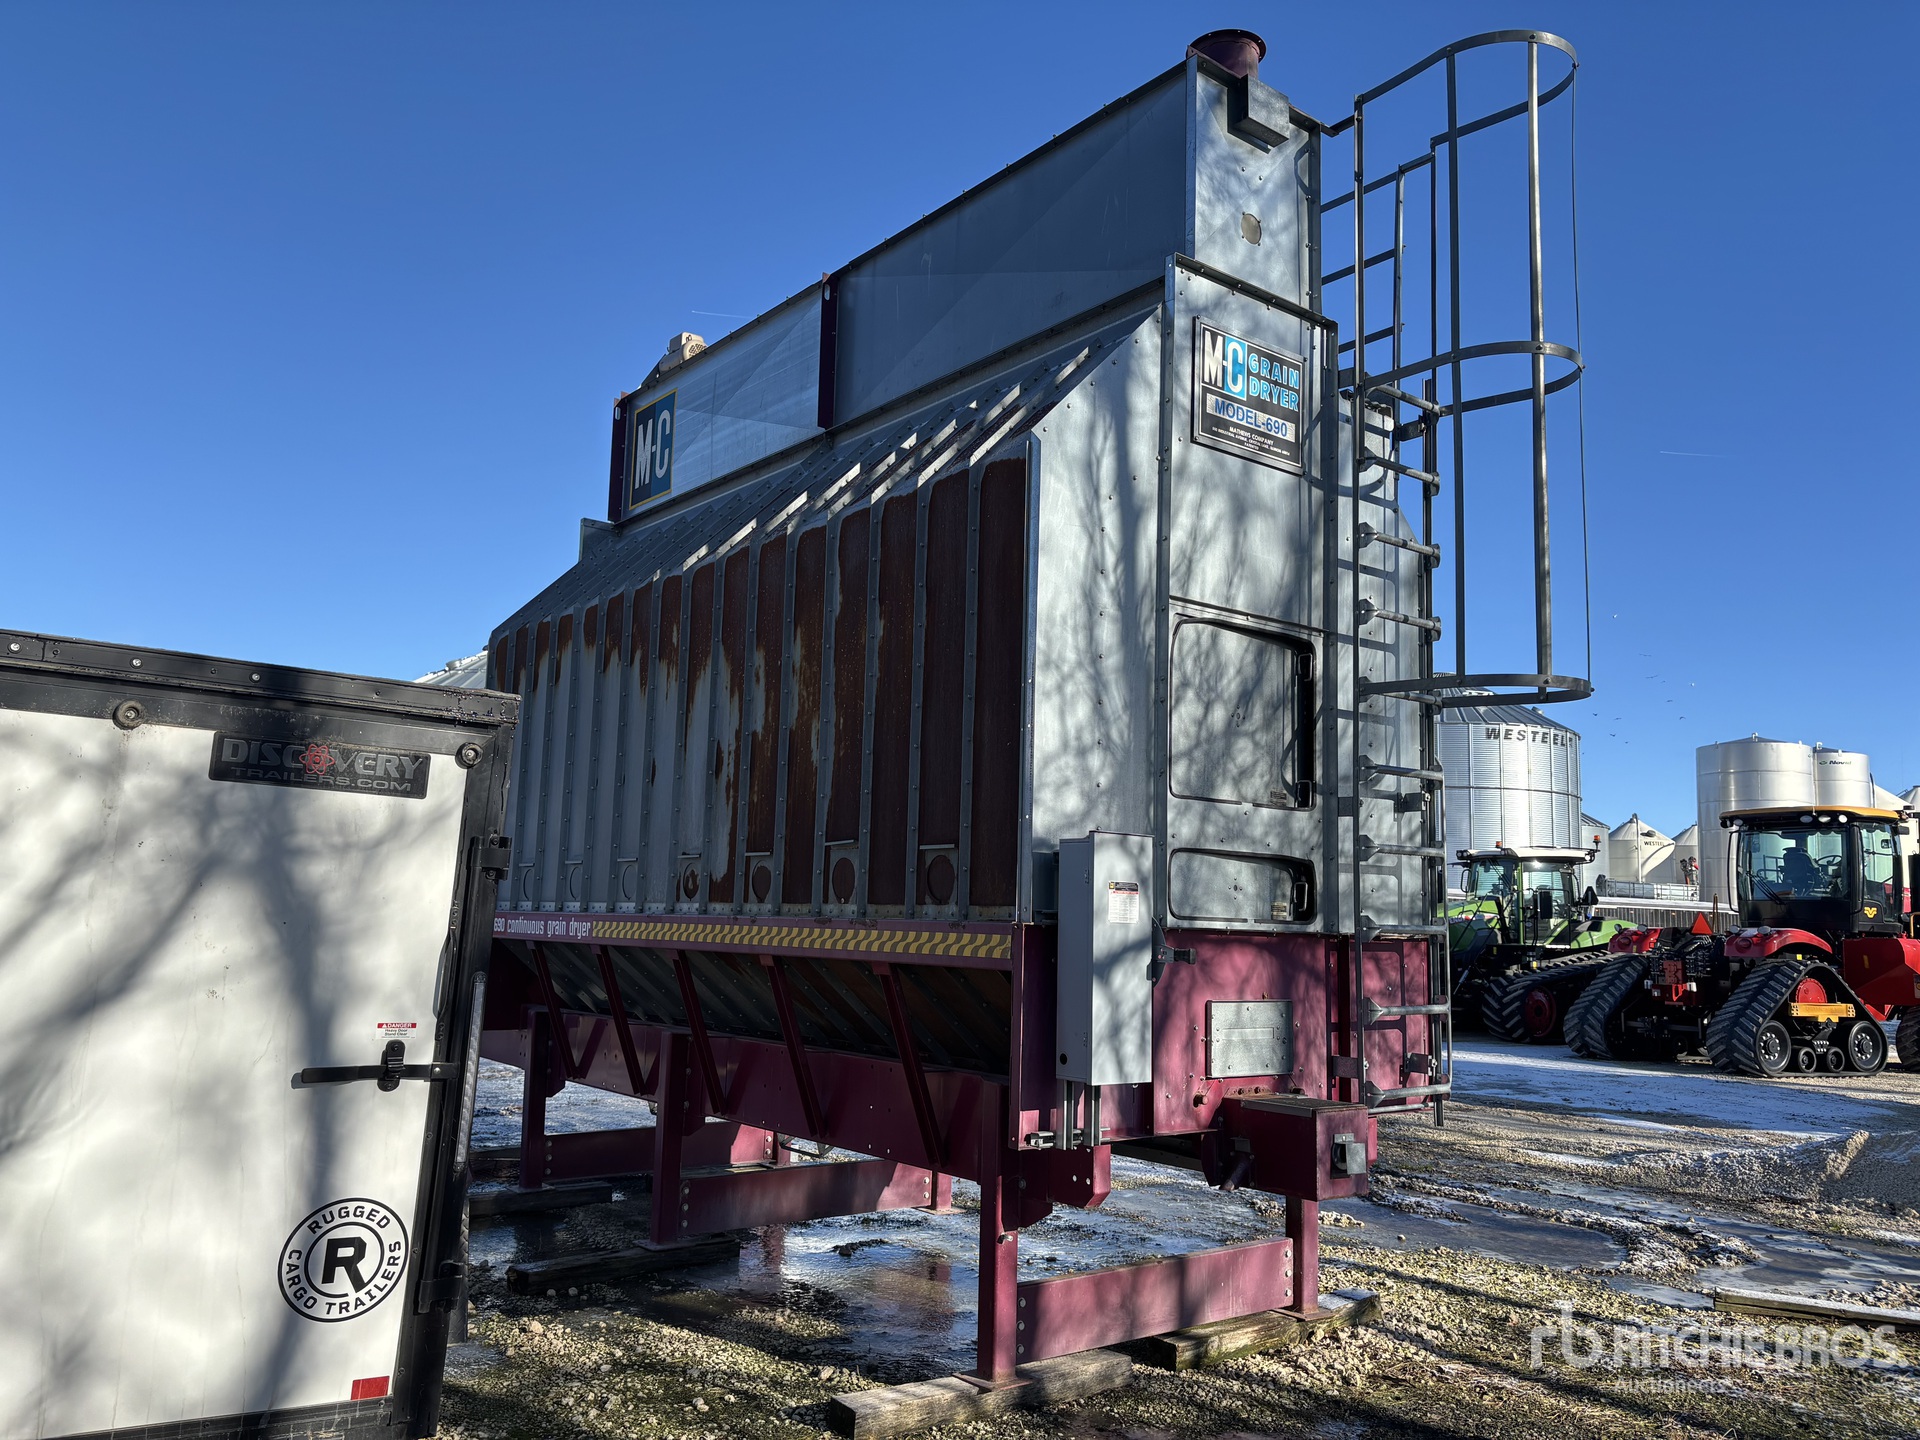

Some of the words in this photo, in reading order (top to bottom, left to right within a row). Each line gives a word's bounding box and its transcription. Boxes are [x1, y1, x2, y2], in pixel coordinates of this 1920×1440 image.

[1204, 330, 1243, 393] M-C
[1248, 353, 1299, 390] GRAIN
[1249, 376, 1299, 412] DRYER
[1215, 398, 1288, 437] MODEL-690
[634, 409, 671, 490] M-C
[1251, 433, 1274, 446] COMPANY
[1485, 727, 1566, 747] WESTEEL
[221, 738, 423, 780] DISCOVERY
[231, 766, 411, 792] TRAILERS.COM
[493, 917, 505, 932] 690
[507, 916, 545, 935] continuous
[547, 917, 566, 938] grain
[569, 917, 591, 940] dryer
[306, 1205, 391, 1235] RUGGED
[286, 1249, 318, 1310] CARGO
[325, 1240, 402, 1315] TRAILERS
[321, 1236, 367, 1293] R
